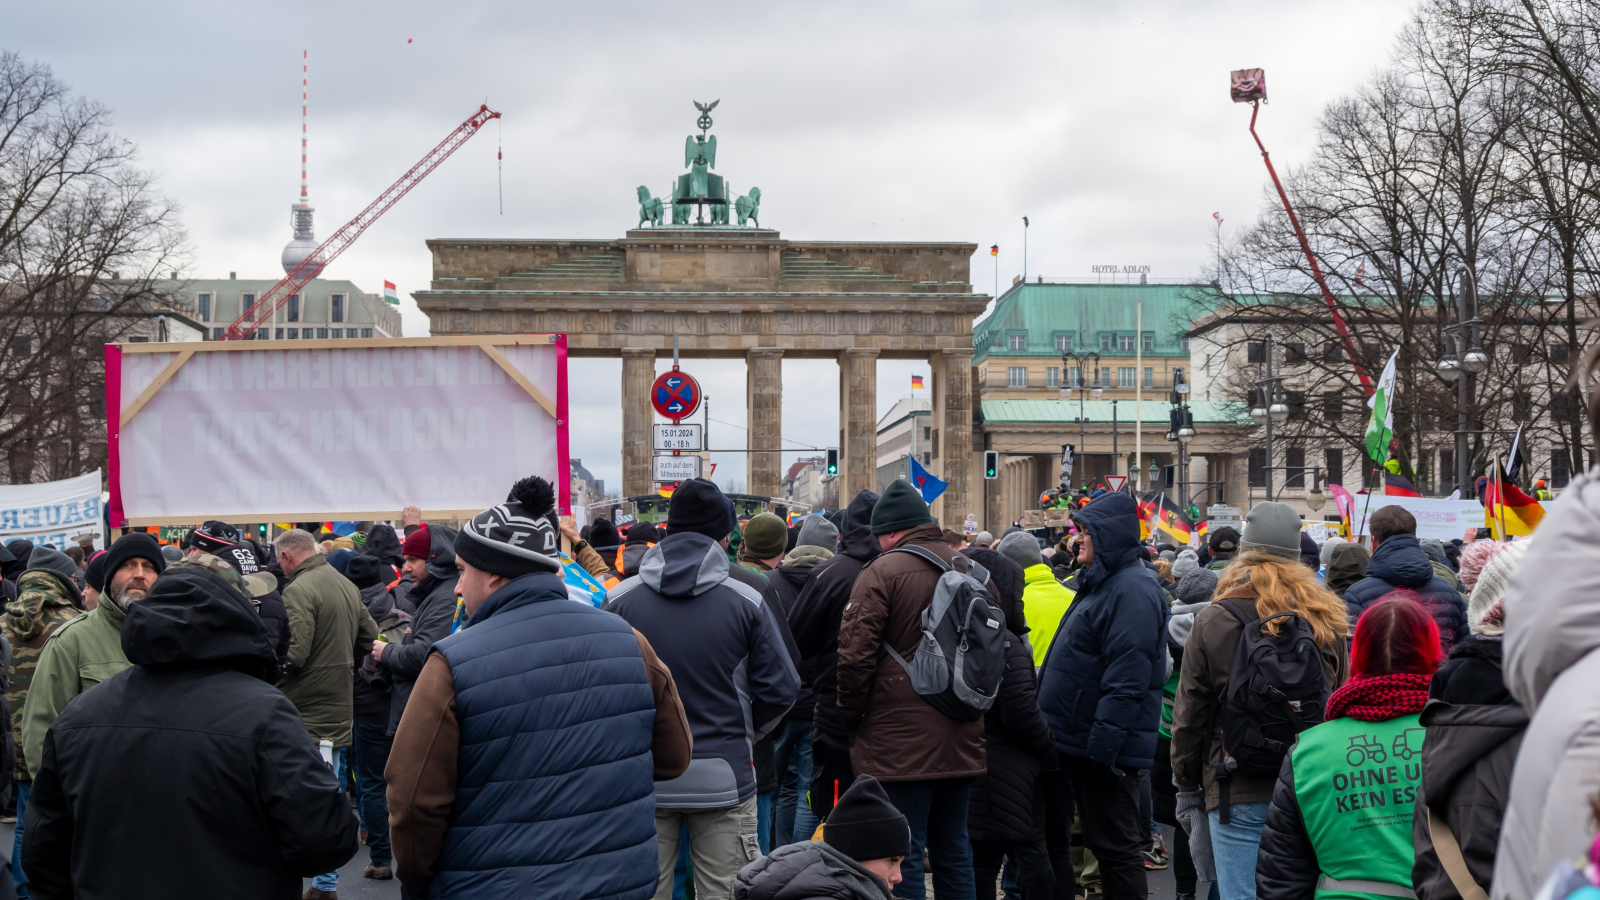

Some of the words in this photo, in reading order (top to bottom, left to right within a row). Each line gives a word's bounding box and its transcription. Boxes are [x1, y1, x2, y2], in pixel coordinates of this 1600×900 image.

[1092, 265, 1120, 273] HOTEL
[1122, 265, 1151, 273] ADLON
[661, 429, 693, 437] 15.01.2024
[232, 549, 254, 560] 63
[1332, 765, 1398, 791] OHNE
[1336, 791, 1386, 813] KEIN
